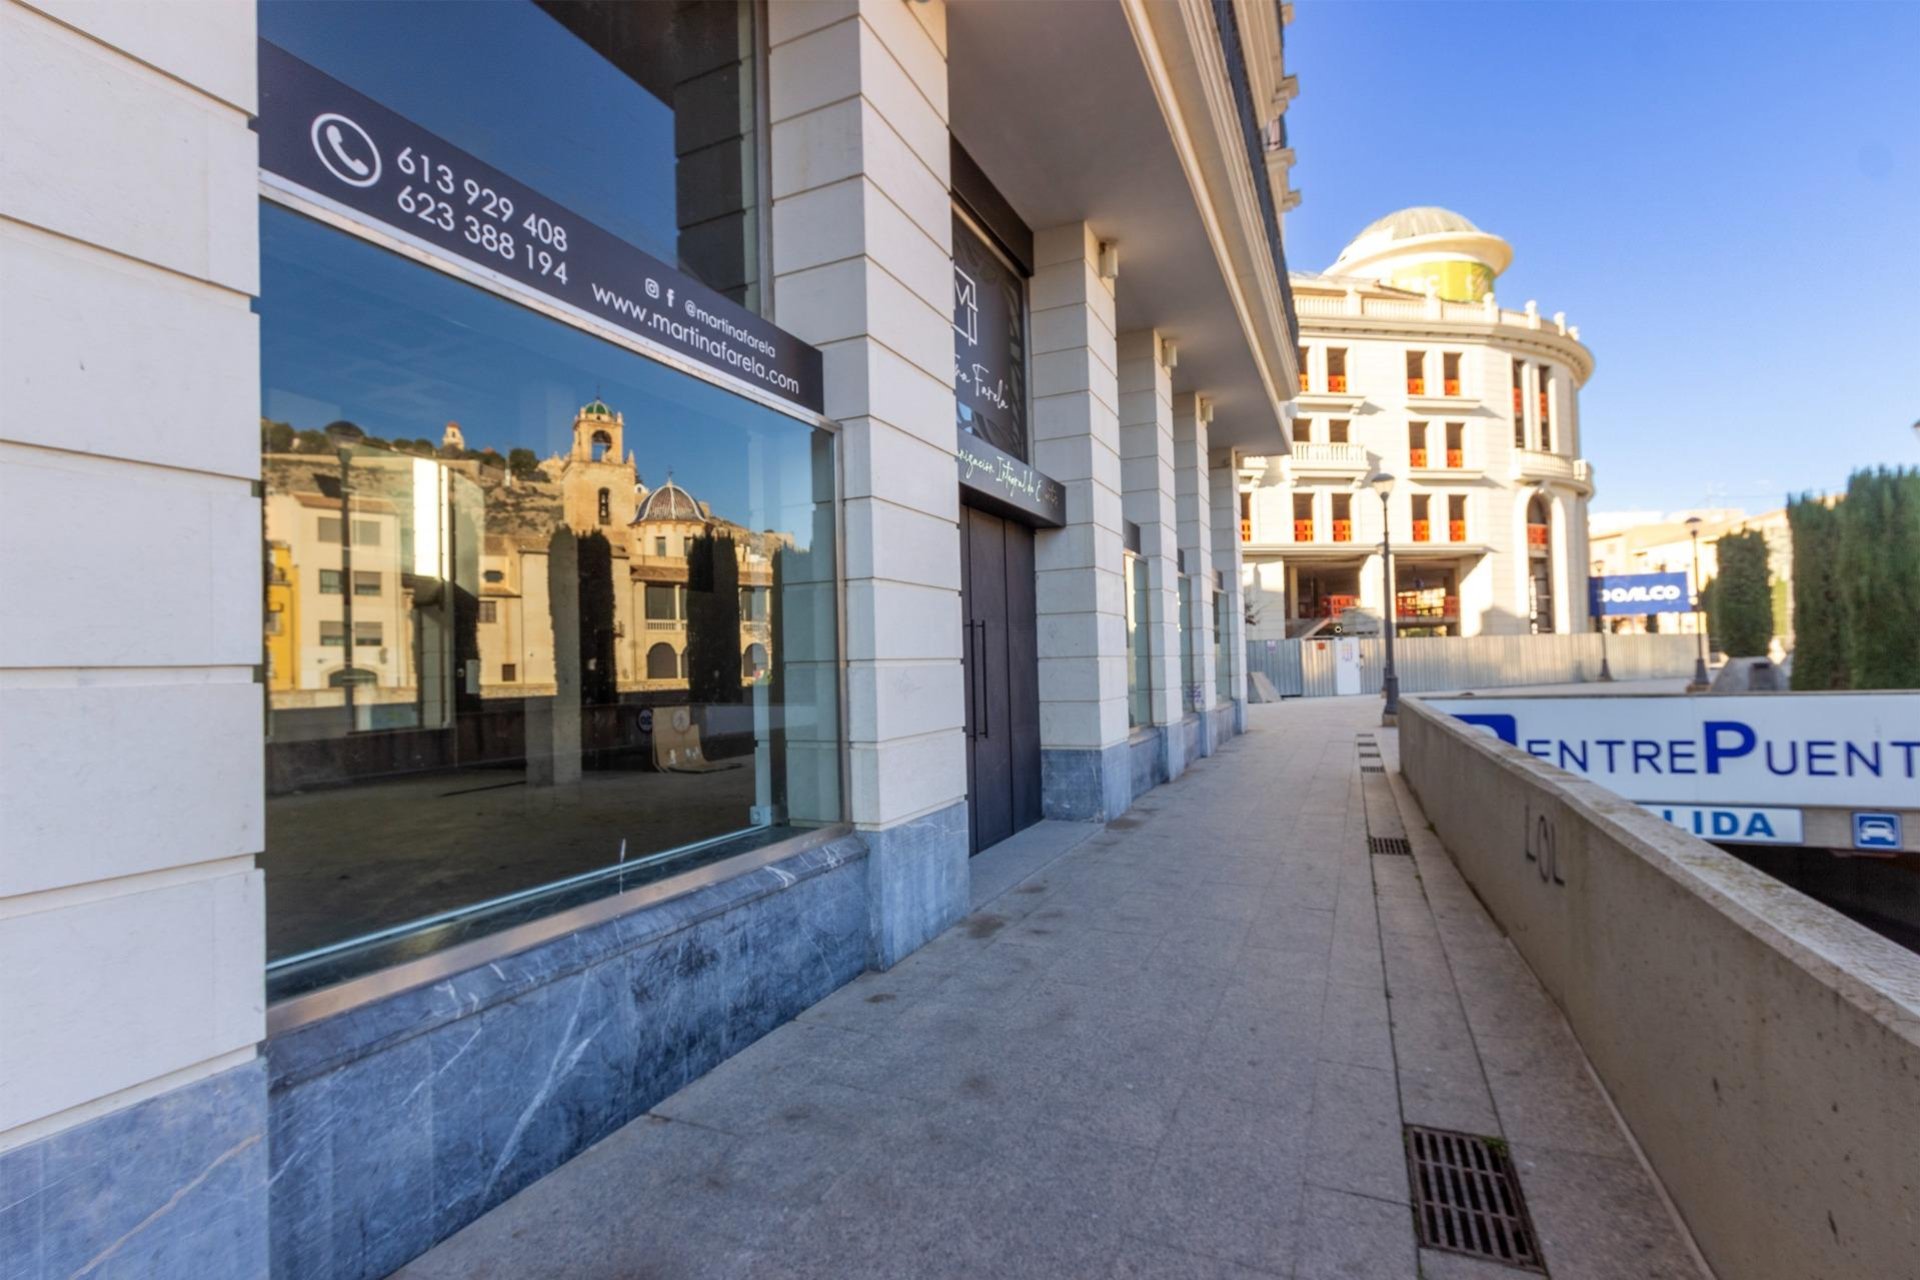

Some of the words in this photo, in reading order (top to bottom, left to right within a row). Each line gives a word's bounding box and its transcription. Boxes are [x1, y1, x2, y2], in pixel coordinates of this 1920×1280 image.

[398, 147, 454, 194] 613
[464, 179, 513, 222] 929
[523, 214, 567, 252] 408
[398, 186, 454, 231] 623
[464, 215, 515, 260] 388
[526, 244, 568, 285] 194
[592, 283, 799, 394] www.martinafarela.com
[685, 300, 776, 358] @martinafarela
[1524, 804, 1565, 888] LOL
